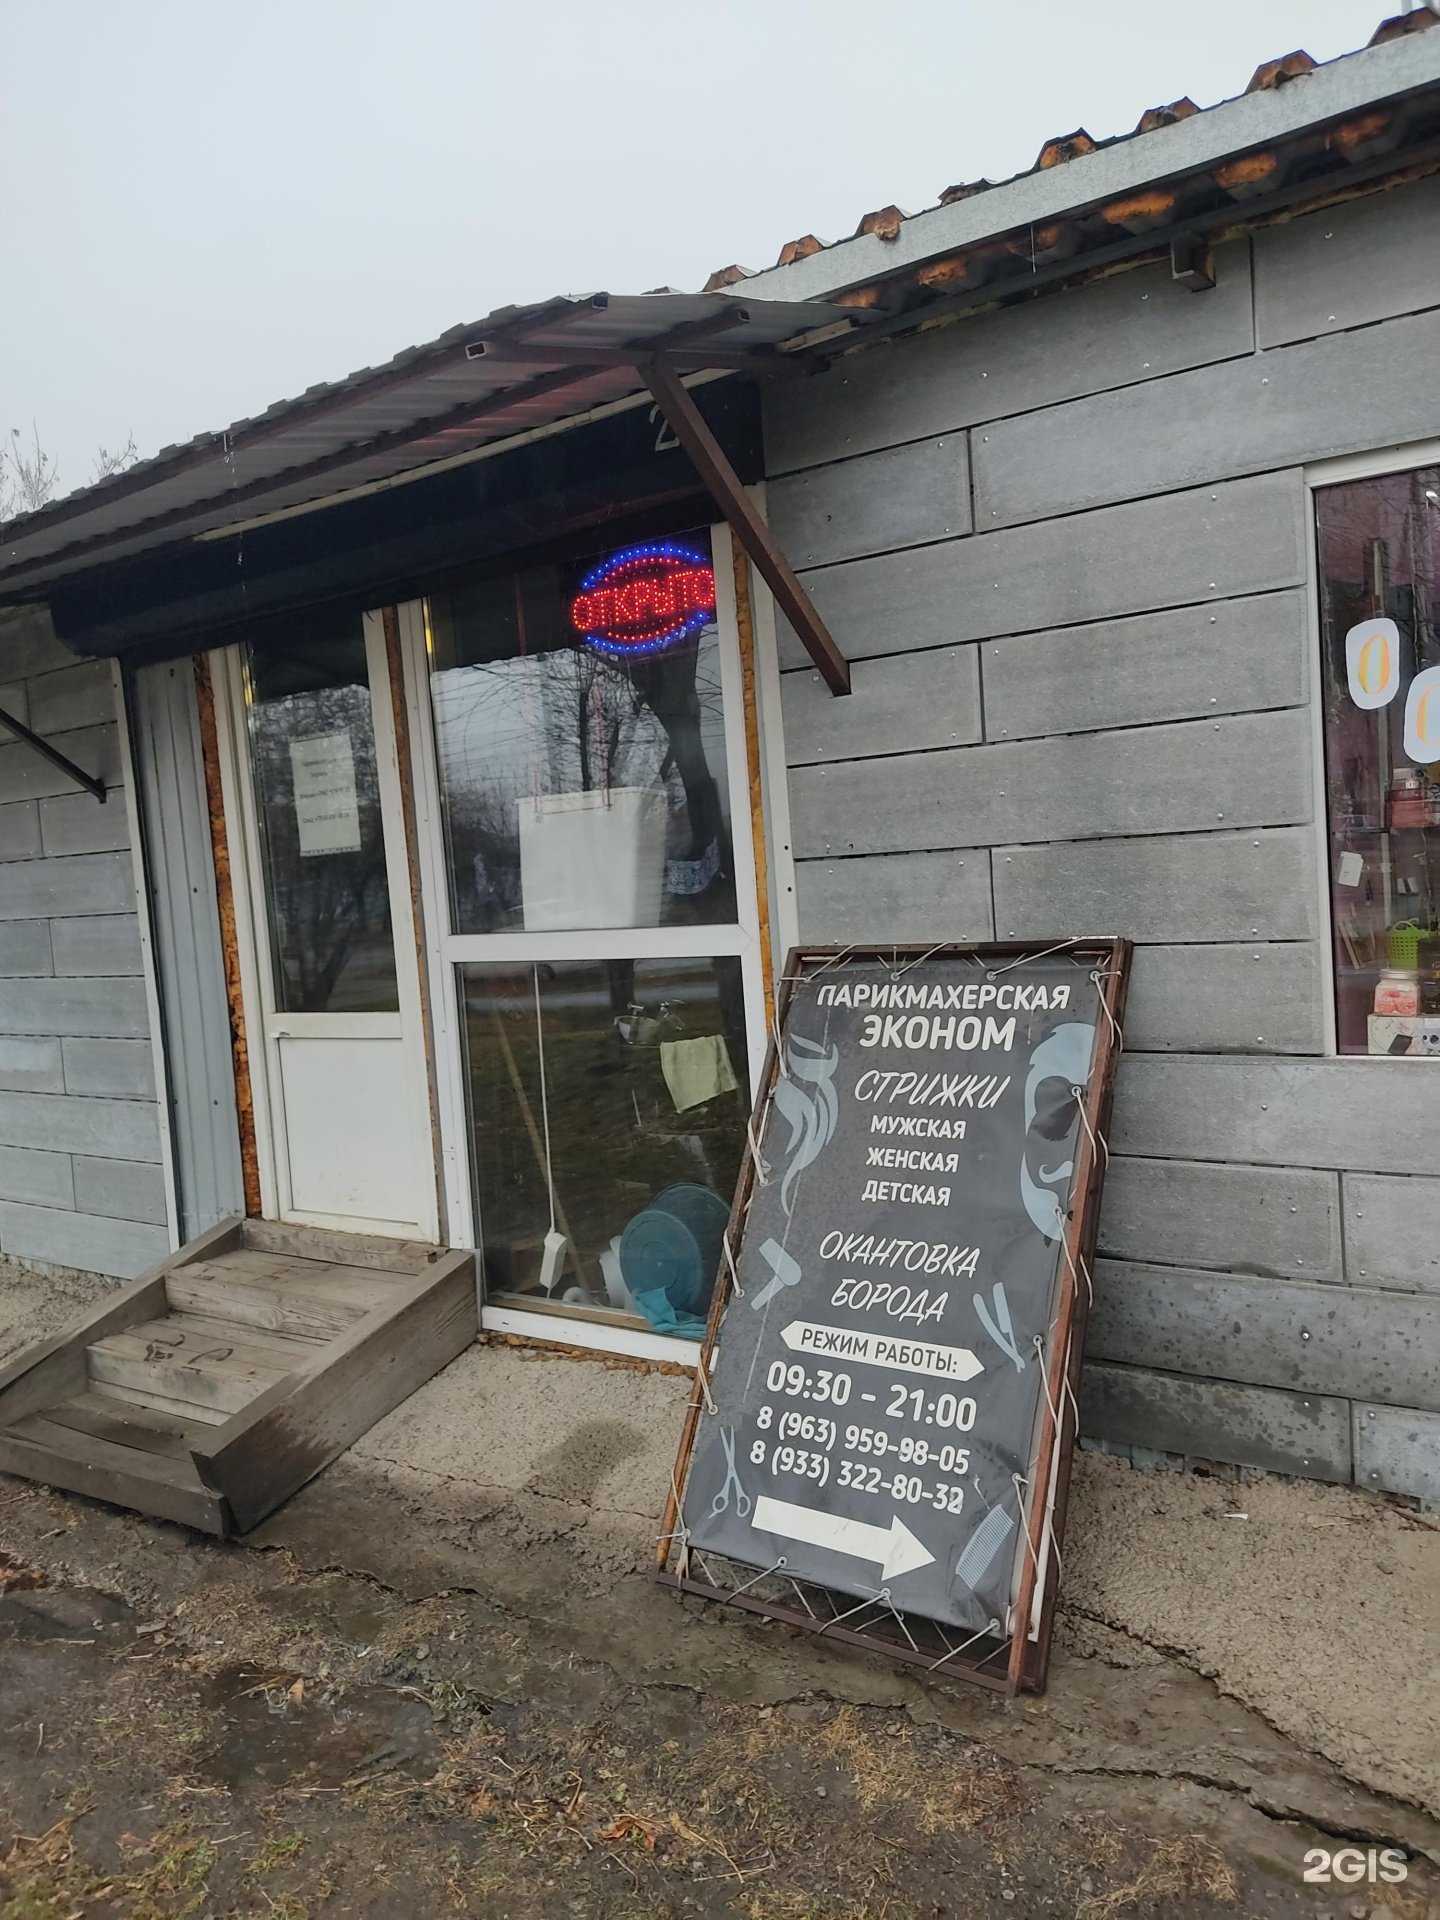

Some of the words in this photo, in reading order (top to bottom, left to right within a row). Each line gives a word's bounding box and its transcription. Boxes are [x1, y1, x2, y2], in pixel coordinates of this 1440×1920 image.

[816, 984, 1071, 1011] ПАРИКМАХЕРСКАЯ
[859, 1014, 1016, 1051] ЭКОНОМ
[854, 1069, 1011, 1108] СТРИЖКИ
[870, 1115, 967, 1139] МУЖСКАЯ
[865, 1147, 959, 1173] ЖЕНСКАЯ
[861, 1180, 951, 1207] ДЕТСКАЯ
[818, 1230, 981, 1279] ОКАНТОВКА
[830, 1278, 949, 1326] БОРОДА
[801, 1328, 869, 1357] РЕЖИМ
[875, 1341, 958, 1373] РАБОТЫ:
[766, 1360, 852, 1406] 09:30
[885, 1384, 977, 1432] 21:00
[756, 1405, 773, 1430] 8
[778, 1411, 837, 1451] (963)
[844, 1424, 971, 1475] 959-98-05
[750, 1439, 766, 1464] 8
[771, 1446, 830, 1487] (933)
